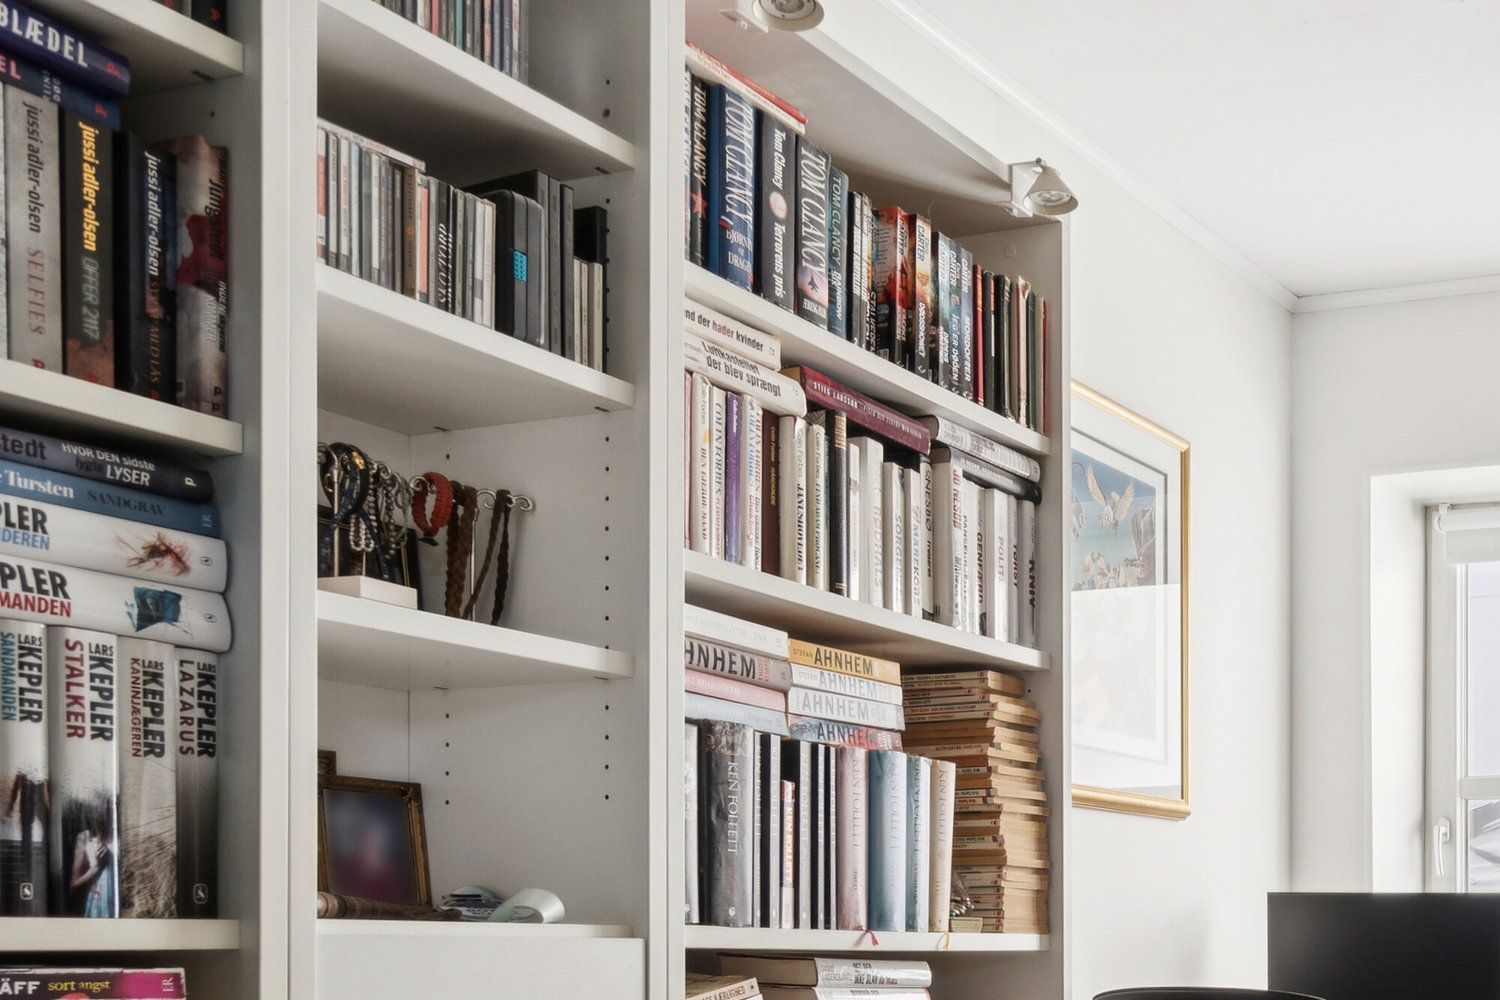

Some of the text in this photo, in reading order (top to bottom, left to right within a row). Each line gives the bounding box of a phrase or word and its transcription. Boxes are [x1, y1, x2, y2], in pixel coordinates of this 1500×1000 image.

[22, 101, 44, 234] jussi adler-olsen
[694, 85, 707, 187] TOM CLANCY
[725, 92, 753, 231] TOM CLANCY
[771, 128, 787, 190] Tom Clancy
[801, 146, 828, 196] TOM
[78, 121, 100, 252] jussi adler-olsen
[144, 151, 162, 276] jussi adler-olsen
[831, 175, 843, 266] TOM CLANCY
[772, 222, 787, 298] Terrorens pris
[801, 197, 827, 281] CLANCY
[917, 224, 926, 262] CARTER
[949, 250, 957, 286] CARTER
[27, 247, 46, 336] SELFIES
[82, 256, 100, 341] OFFER 2117
[696, 312, 764, 353] der hader kvinder
[706, 355, 782, 397] der blev sprængt
[812, 381, 859, 409] STIEG LARSSON
[4, 469, 75, 499] Tursten
[61, 442, 156, 471] HVOR DEN sidste
[106, 464, 151, 487] LYSER
[714, 402, 723, 496] COLIN FORBES
[86, 489, 167, 516] SANDGRAV
[912, 523, 921, 606] MAREKORS
[976, 531, 984, 604] GENFÆRD
[18, 633, 43, 647] LARS
[88, 642, 114, 657] LARS
[142, 659, 164, 672] LARS
[197, 661, 217, 673] LARS
[685, 640, 756, 680] HNHEM
[814, 647, 874, 677] AHNHEM
[1, 632, 17, 722] SANDMANDEN
[18, 646, 43, 724] KEPLER
[65, 638, 86, 740] STALKER
[89, 655, 115, 742] KEPLER
[130, 657, 143, 758] KANINJÆGEREN
[179, 659, 195, 756] LAZARUS
[802, 692, 870, 721] AHNHEM
[819, 670, 878, 699] AHNHEM
[143, 670, 165, 759] KEPLER
[197, 672, 217, 759] KEPLER
[727, 761, 739, 856] KEN FOLLETT
[786, 806, 794, 832] KEN
[851, 759, 864, 848] KEN FOLLETT
[936, 769, 947, 796] KEN
[47, 979, 111, 994] sort angst
